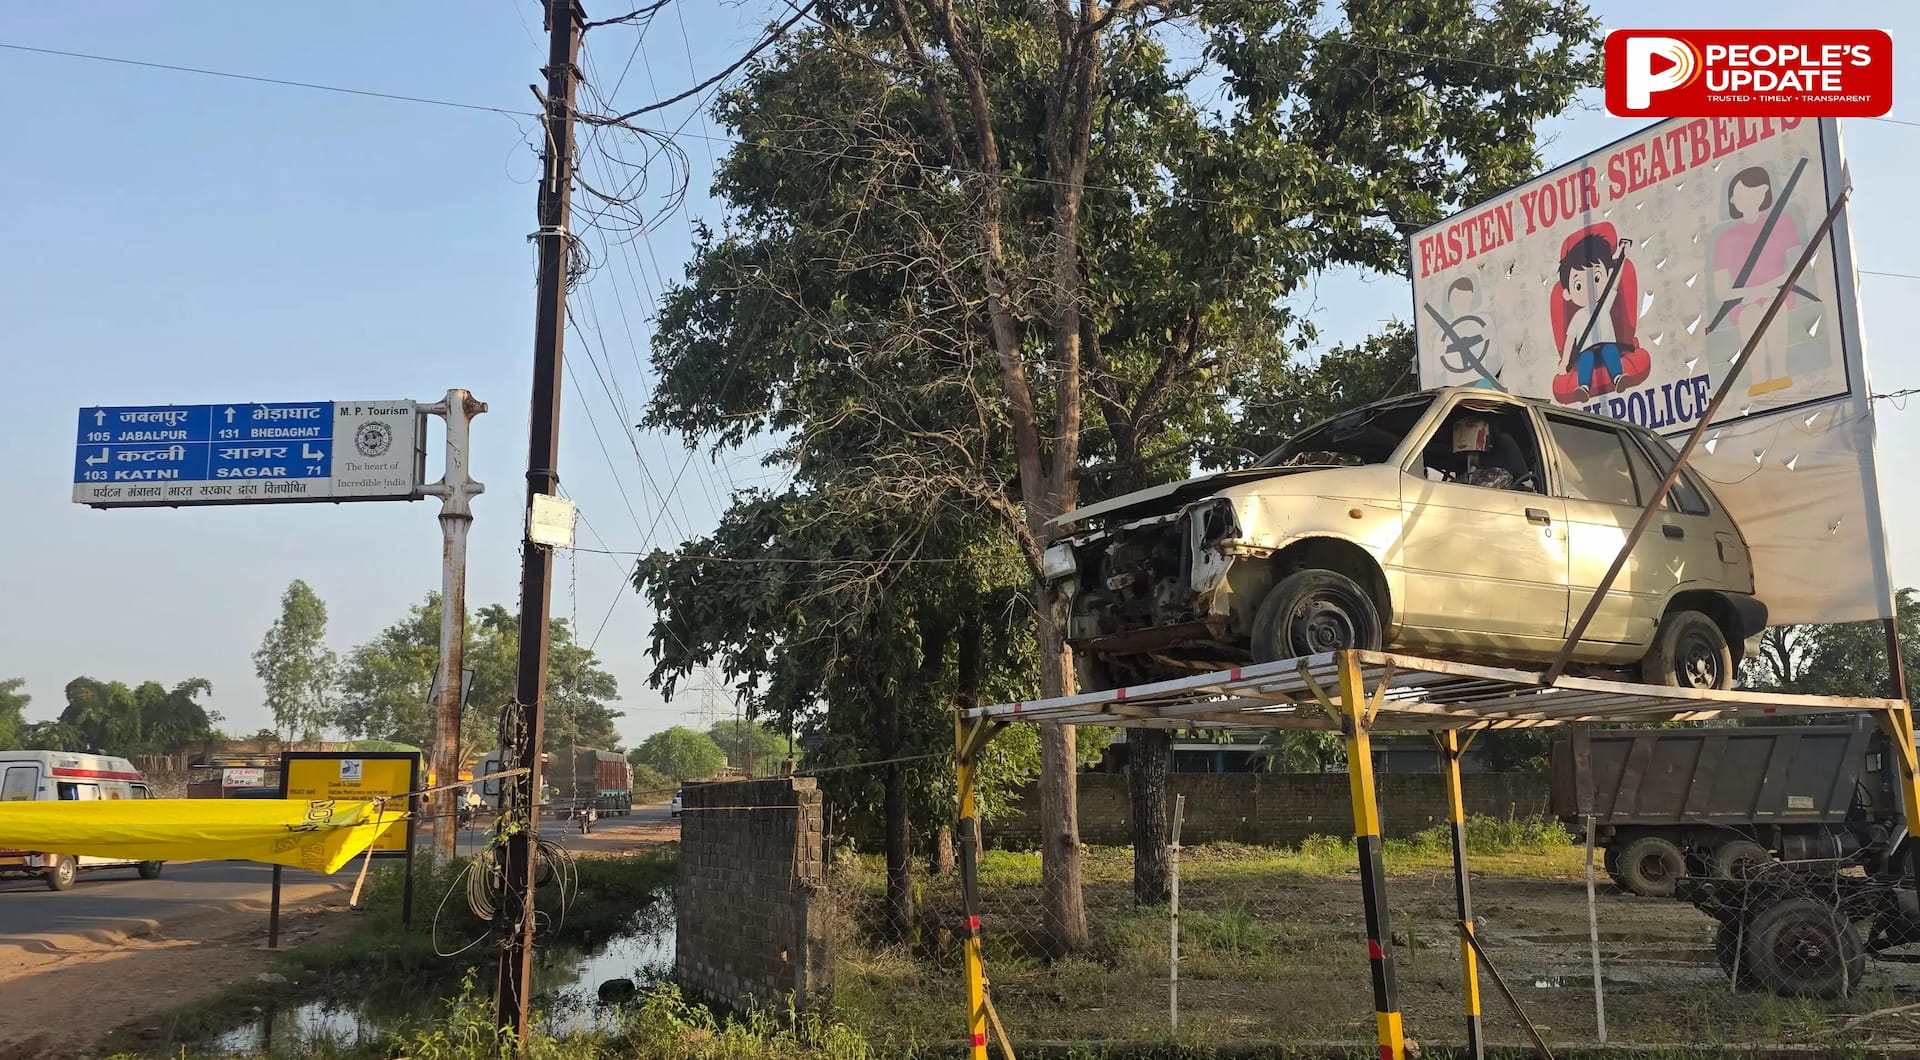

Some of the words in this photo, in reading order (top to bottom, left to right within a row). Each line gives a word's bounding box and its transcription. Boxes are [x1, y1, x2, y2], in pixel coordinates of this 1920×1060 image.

[1419, 201, 1514, 278] FASTEN
[1520, 166, 1600, 235] YOUR
[1607, 117, 1802, 202] SEATBEL
[1608, 374, 1713, 429] POLICE
[252, 404, 322, 422] भेड़ाघाट
[340, 407, 352, 416] M.
[355, 407, 363, 416] P.
[368, 406, 409, 416] Tourism
[119, 410, 189, 427] जबलपुर
[87, 431, 111, 441] 105
[118, 430, 188, 441] JABALPUR
[218, 429, 240, 439] 131
[250, 427, 321, 438] BHEDAGHAT
[117, 445, 187, 462] कटनी
[218, 446, 289, 460] सागर
[216, 466, 287, 478] SAGAR
[306, 465, 322, 476] 71
[345, 462, 362, 471] The
[364, 462, 387, 471] heart
[389, 461, 399, 471] of
[83, 471, 108, 481] 103
[114, 468, 179, 480] KATNI
[337, 478, 381, 488] Incredible
[93, 484, 121, 498] पर्यटन
[127, 484, 161, 497] मंत्रालय
[168, 486, 193, 496] भारत
[200, 485, 232, 496] सरकार
[238, 485, 257, 495] द्वारा
